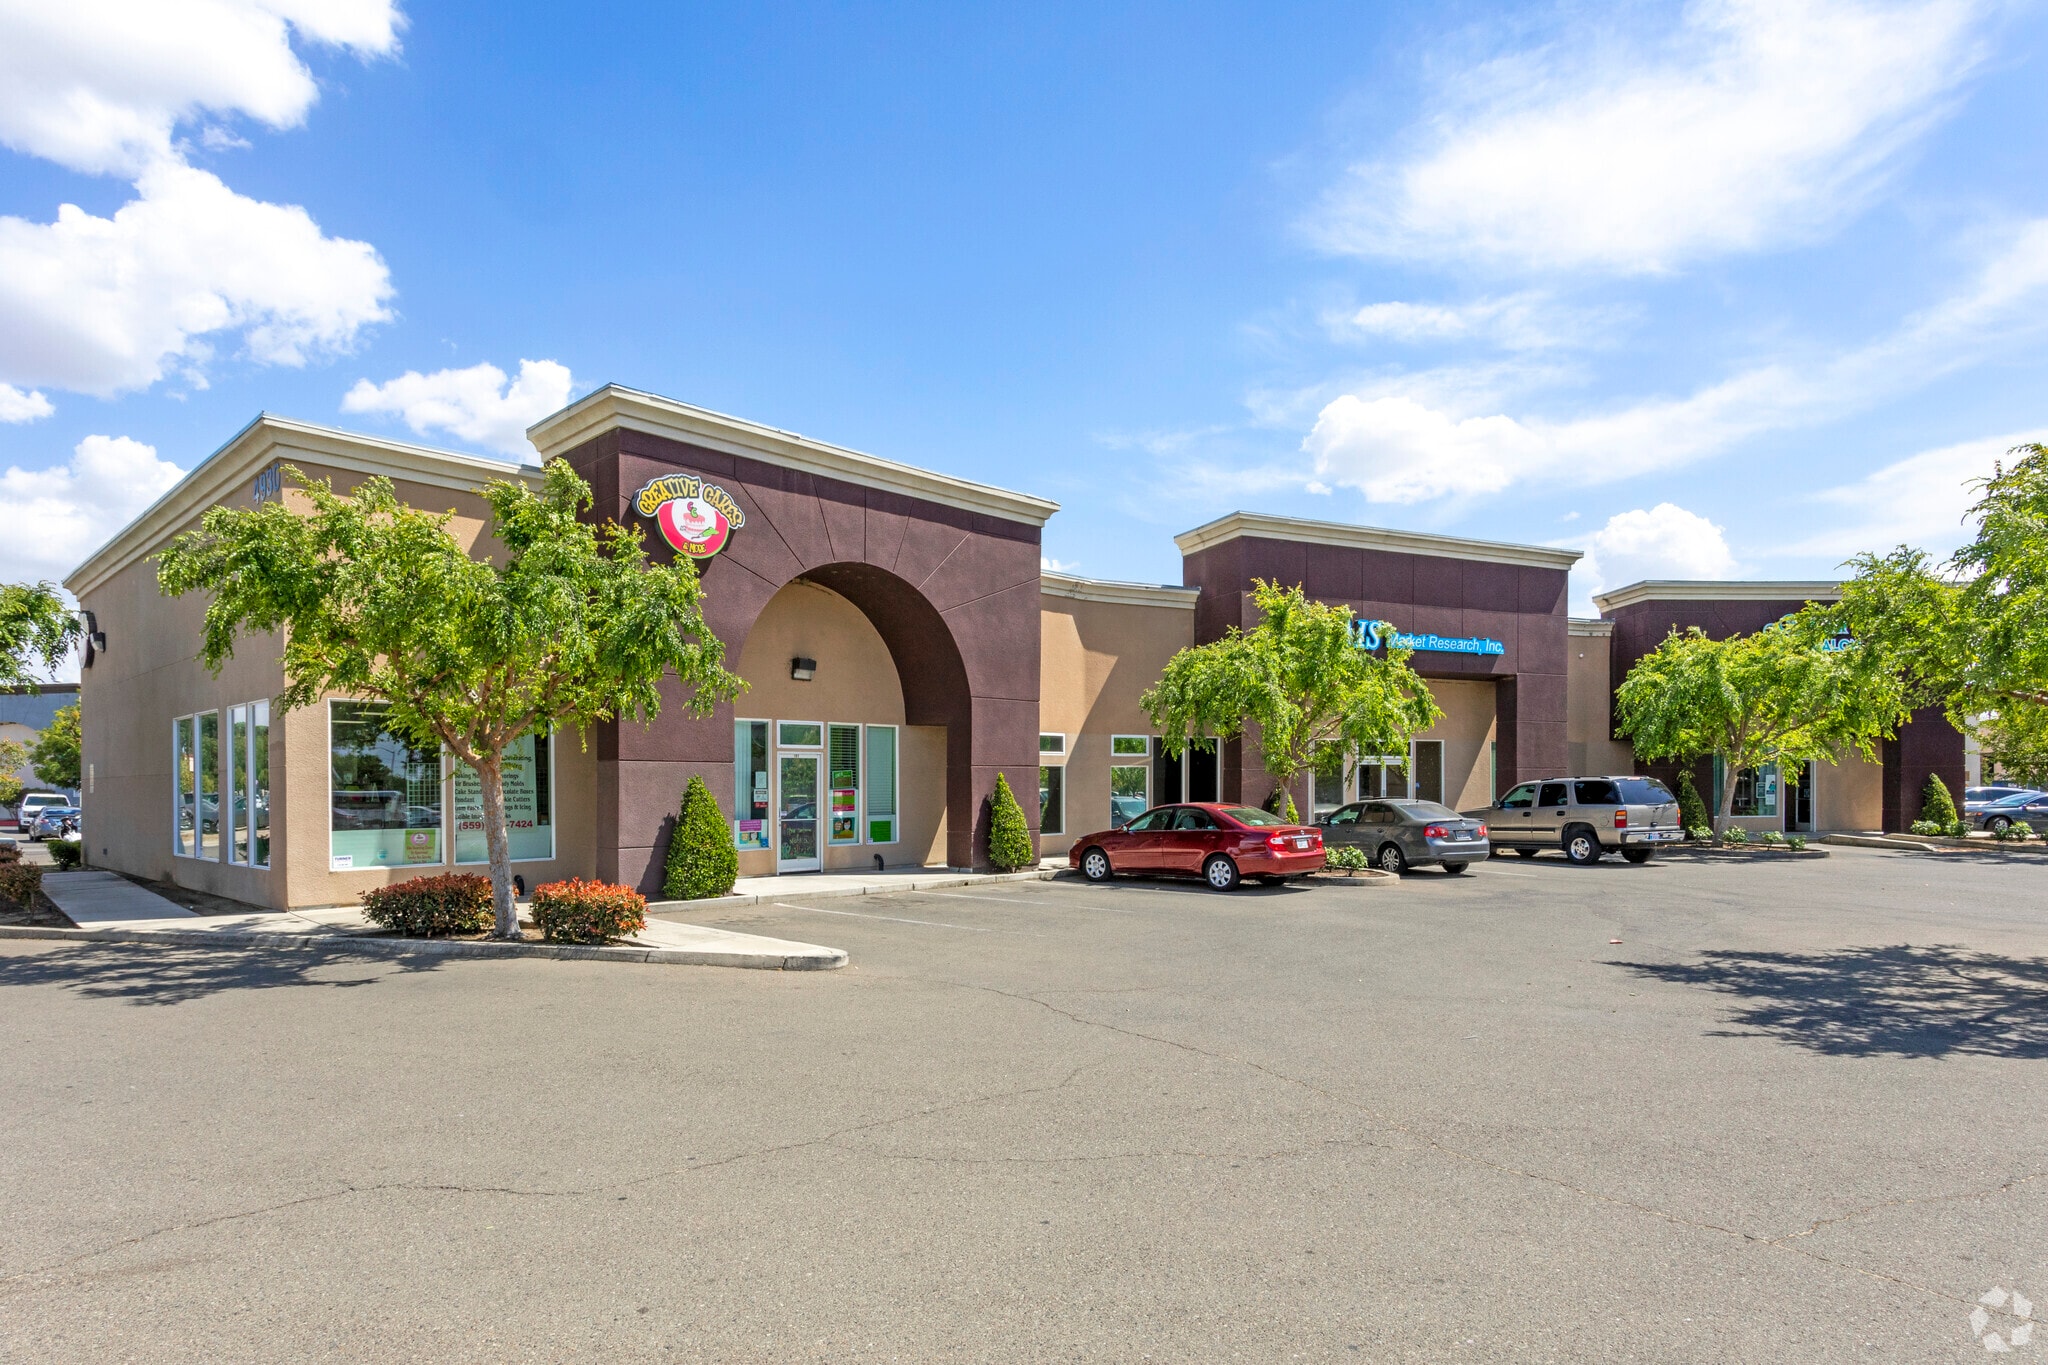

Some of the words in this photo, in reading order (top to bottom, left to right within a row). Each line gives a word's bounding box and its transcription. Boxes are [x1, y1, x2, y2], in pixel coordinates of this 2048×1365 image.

[638, 476, 700, 514] CREATIVE
[703, 485, 743, 527] CAKES
[1429, 637, 1483, 653] Research,
[1485, 638, 1504, 654] Inc.
[459, 821, 484, 831] (559)
[506, 820, 533, 828] -7424
